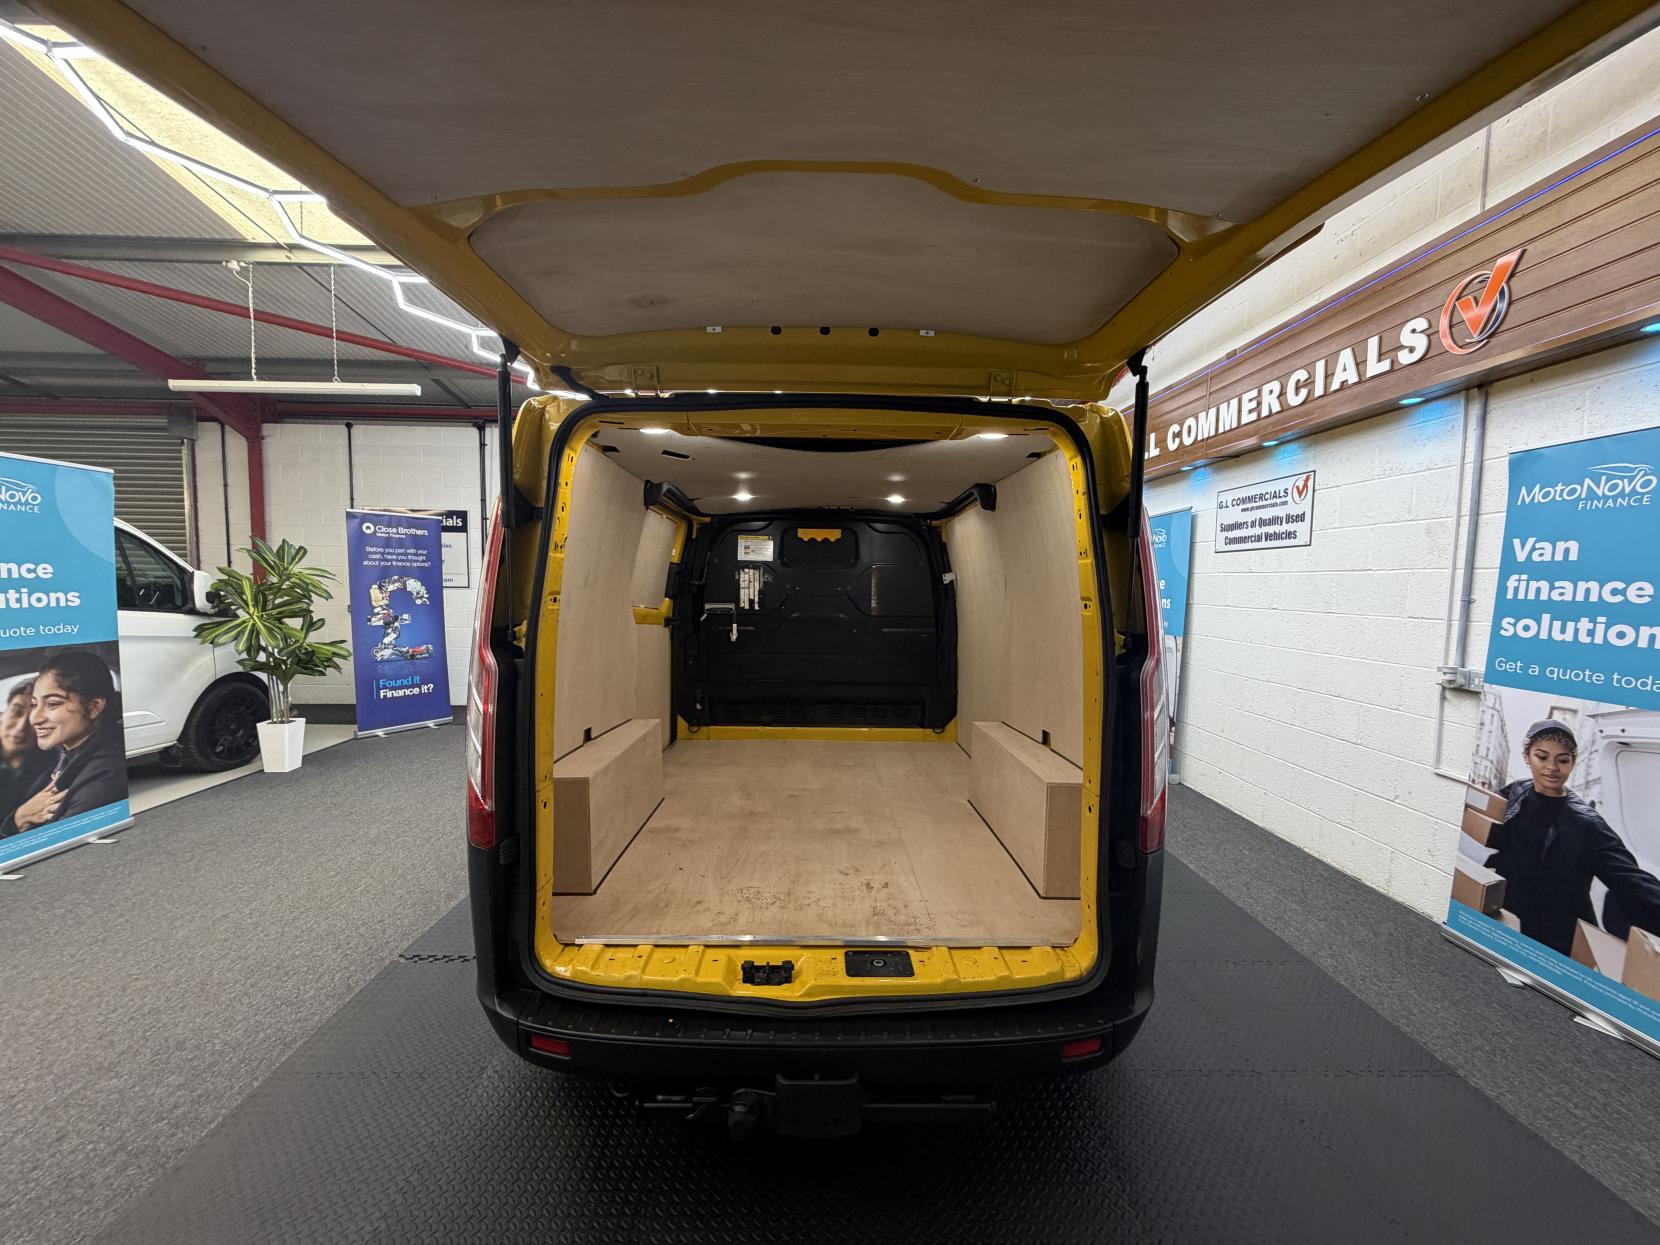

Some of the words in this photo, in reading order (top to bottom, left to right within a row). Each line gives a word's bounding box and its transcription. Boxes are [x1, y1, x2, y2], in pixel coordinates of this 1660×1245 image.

[1167, 317, 1431, 452] COMMERCIALS
[1231, 488, 1289, 507] COMMERCIALS
[1577, 494, 1652, 511] FINANCE
[0, 503, 41, 514] NANCE
[375, 525, 398, 534] Close
[398, 526, 429, 536] Brothers
[1219, 520, 1249, 533] Suppliers
[1250, 517, 1257, 529] of
[1258, 515, 1284, 528] Quality
[1285, 511, 1306, 524] Used
[1224, 532, 1263, 546] Commercial
[1264, 529, 1298, 543] Vehicles
[1512, 537, 1580, 563] Van
[0, 587, 81, 609] tions
[1506, 574, 1655, 604] finance
[0, 626, 35, 638] uote
[39, 622, 80, 635] today
[1499, 613, 1660, 650] solution
[379, 676, 412, 688] Found
[413, 675, 422, 684] it
[1495, 657, 1524, 674] Get
[1528, 663, 1539, 676] a
[1545, 665, 1605, 685] quote
[1612, 672, 1660, 693] toda
[380, 687, 420, 699] Finance
[421, 683, 434, 694] it?
